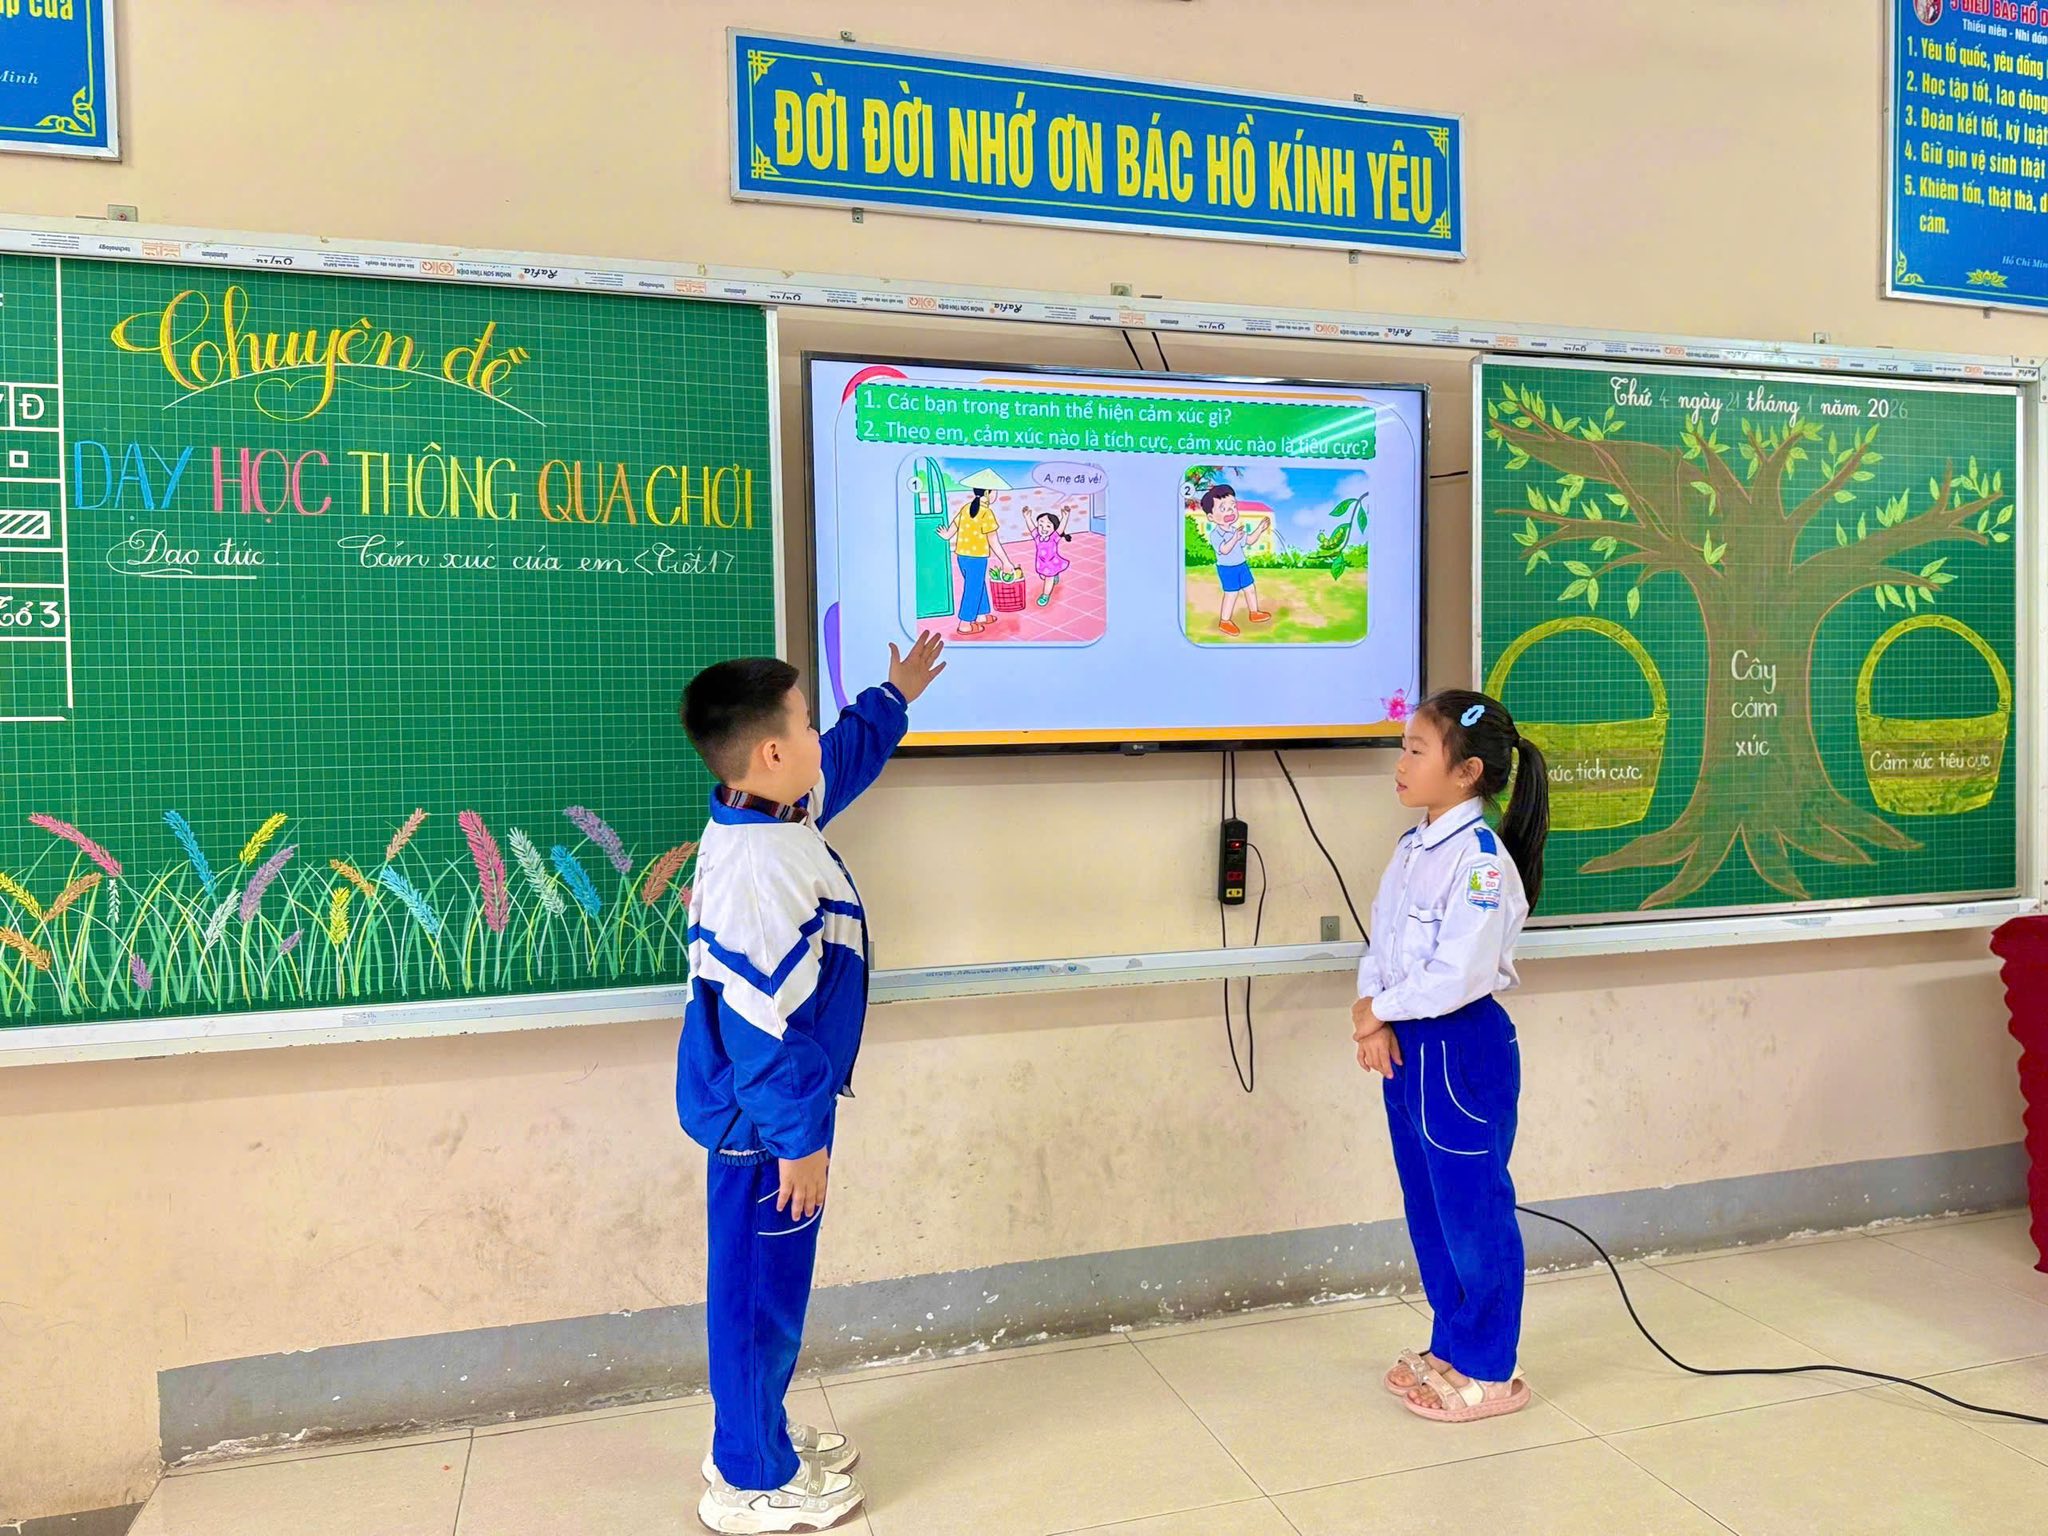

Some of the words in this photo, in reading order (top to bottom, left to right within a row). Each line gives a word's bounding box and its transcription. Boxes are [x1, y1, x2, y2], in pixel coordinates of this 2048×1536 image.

[1962, 18, 1986, 34] Thiếu
[1988, 24, 2007, 38] niên
[2015, 28, 2030, 42] Nhi
[1907, 36, 1918, 57] 1.
[1921, 38, 1942, 61] Yêu
[1945, 38, 1958, 63] tổ
[1960, 43, 1991, 72] quốc,
[1994, 51, 2013, 73] yêu
[2017, 53, 2043, 81] đồng
[1906, 70, 1918, 92] 2.
[1922, 72, 1945, 99] Học
[1949, 77, 1969, 103] tập
[1972, 78, 1992, 106] tốt,
[1996, 84, 2015, 107] lao
[2019, 88, 2048, 115] động
[1905, 105, 1917, 127] 3.
[1921, 107, 1953, 132] Đoàn
[1957, 111, 1978, 135] kết
[1981, 113, 2002, 141] tốt,
[774, 72, 849, 170] ĐỜI
[863, 81, 933, 178] ĐỜI
[950, 91, 1034, 187] NHỚ
[1049, 115, 1103, 194] ƠN
[1118, 112, 1194, 203] BÁC
[1208, 114, 1256, 209] HỒ
[1269, 128, 1356, 218] KÍNH
[1367, 140, 1432, 225] YÊU
[1904, 139, 1917, 161] 4.
[1921, 141, 1943, 165] Giữ
[1947, 146, 1967, 169] gìn
[1971, 150, 1986, 175] vệ
[1990, 153, 2017, 175] sinh
[2020, 156, 2045, 183] thật
[1904, 174, 1916, 196] 5.
[1920, 176, 1959, 201] Khiêm
[1962, 179, 1985, 207] tốn,
[1988, 186, 2012, 213] thật
[2014, 189, 2037, 214] thà,
[1919, 209, 1950, 234] cảm.
[111, 286, 424, 421] Chuyên
[443, 321, 531, 398] đề
[19, 394, 45, 420] Đ
[863, 390, 881, 409] 1.
[887, 392, 919, 411] Các
[925, 394, 957, 415] bạn
[963, 398, 1009, 419] trong
[1015, 400, 1060, 418] tranh
[1065, 400, 1094, 420] thể
[1098, 403, 1134, 422] hiện
[1138, 404, 1172, 422] cảm
[1177, 407, 1204, 424] xúc
[1209, 408, 1232, 428] gì?
[1610, 376, 1653, 407] Thứ
[1678, 391, 1723, 426] ngày
[1746, 384, 1800, 428] tháng
[1820, 398, 1861, 417] năm
[863, 420, 880, 438] 2.
[886, 421, 930, 439] Theo
[936, 427, 968, 443] em,
[974, 424, 1009, 443] cảm
[1014, 427, 1044, 445] xúc
[1049, 428, 1080, 446] nào
[1085, 427, 1099, 446] là
[1104, 431, 1134, 448] tích
[1139, 434, 1173, 451] cực,
[1178, 434, 1211, 451] cảm
[1215, 435, 1243, 452] xúc
[1247, 437, 1276, 453] nào
[1281, 436, 1294, 454] là
[1332, 439, 1369, 458] cực?
[74, 440, 194, 521] DẠY
[212, 446, 332, 524] HỌC
[348, 441, 522, 521] THÔNG
[537, 459, 637, 526] QUA
[645, 463, 753, 530] CHƠI
[1184, 486, 1192, 496] 2
[214, 537, 265, 566] đức
[577, 557, 629, 574] em
[39, 601, 61, 628] 3
[1731, 649, 1777, 695] Cây
[1731, 695, 1778, 719] cảm
[1735, 734, 1770, 756] xúc
[1870, 750, 1908, 771] Cảm
[1912, 752, 1934, 769] xúc
[1939, 751, 1964, 769] tiêu
[1576, 758, 1606, 781] tích
[1610, 765, 1643, 783] cực
